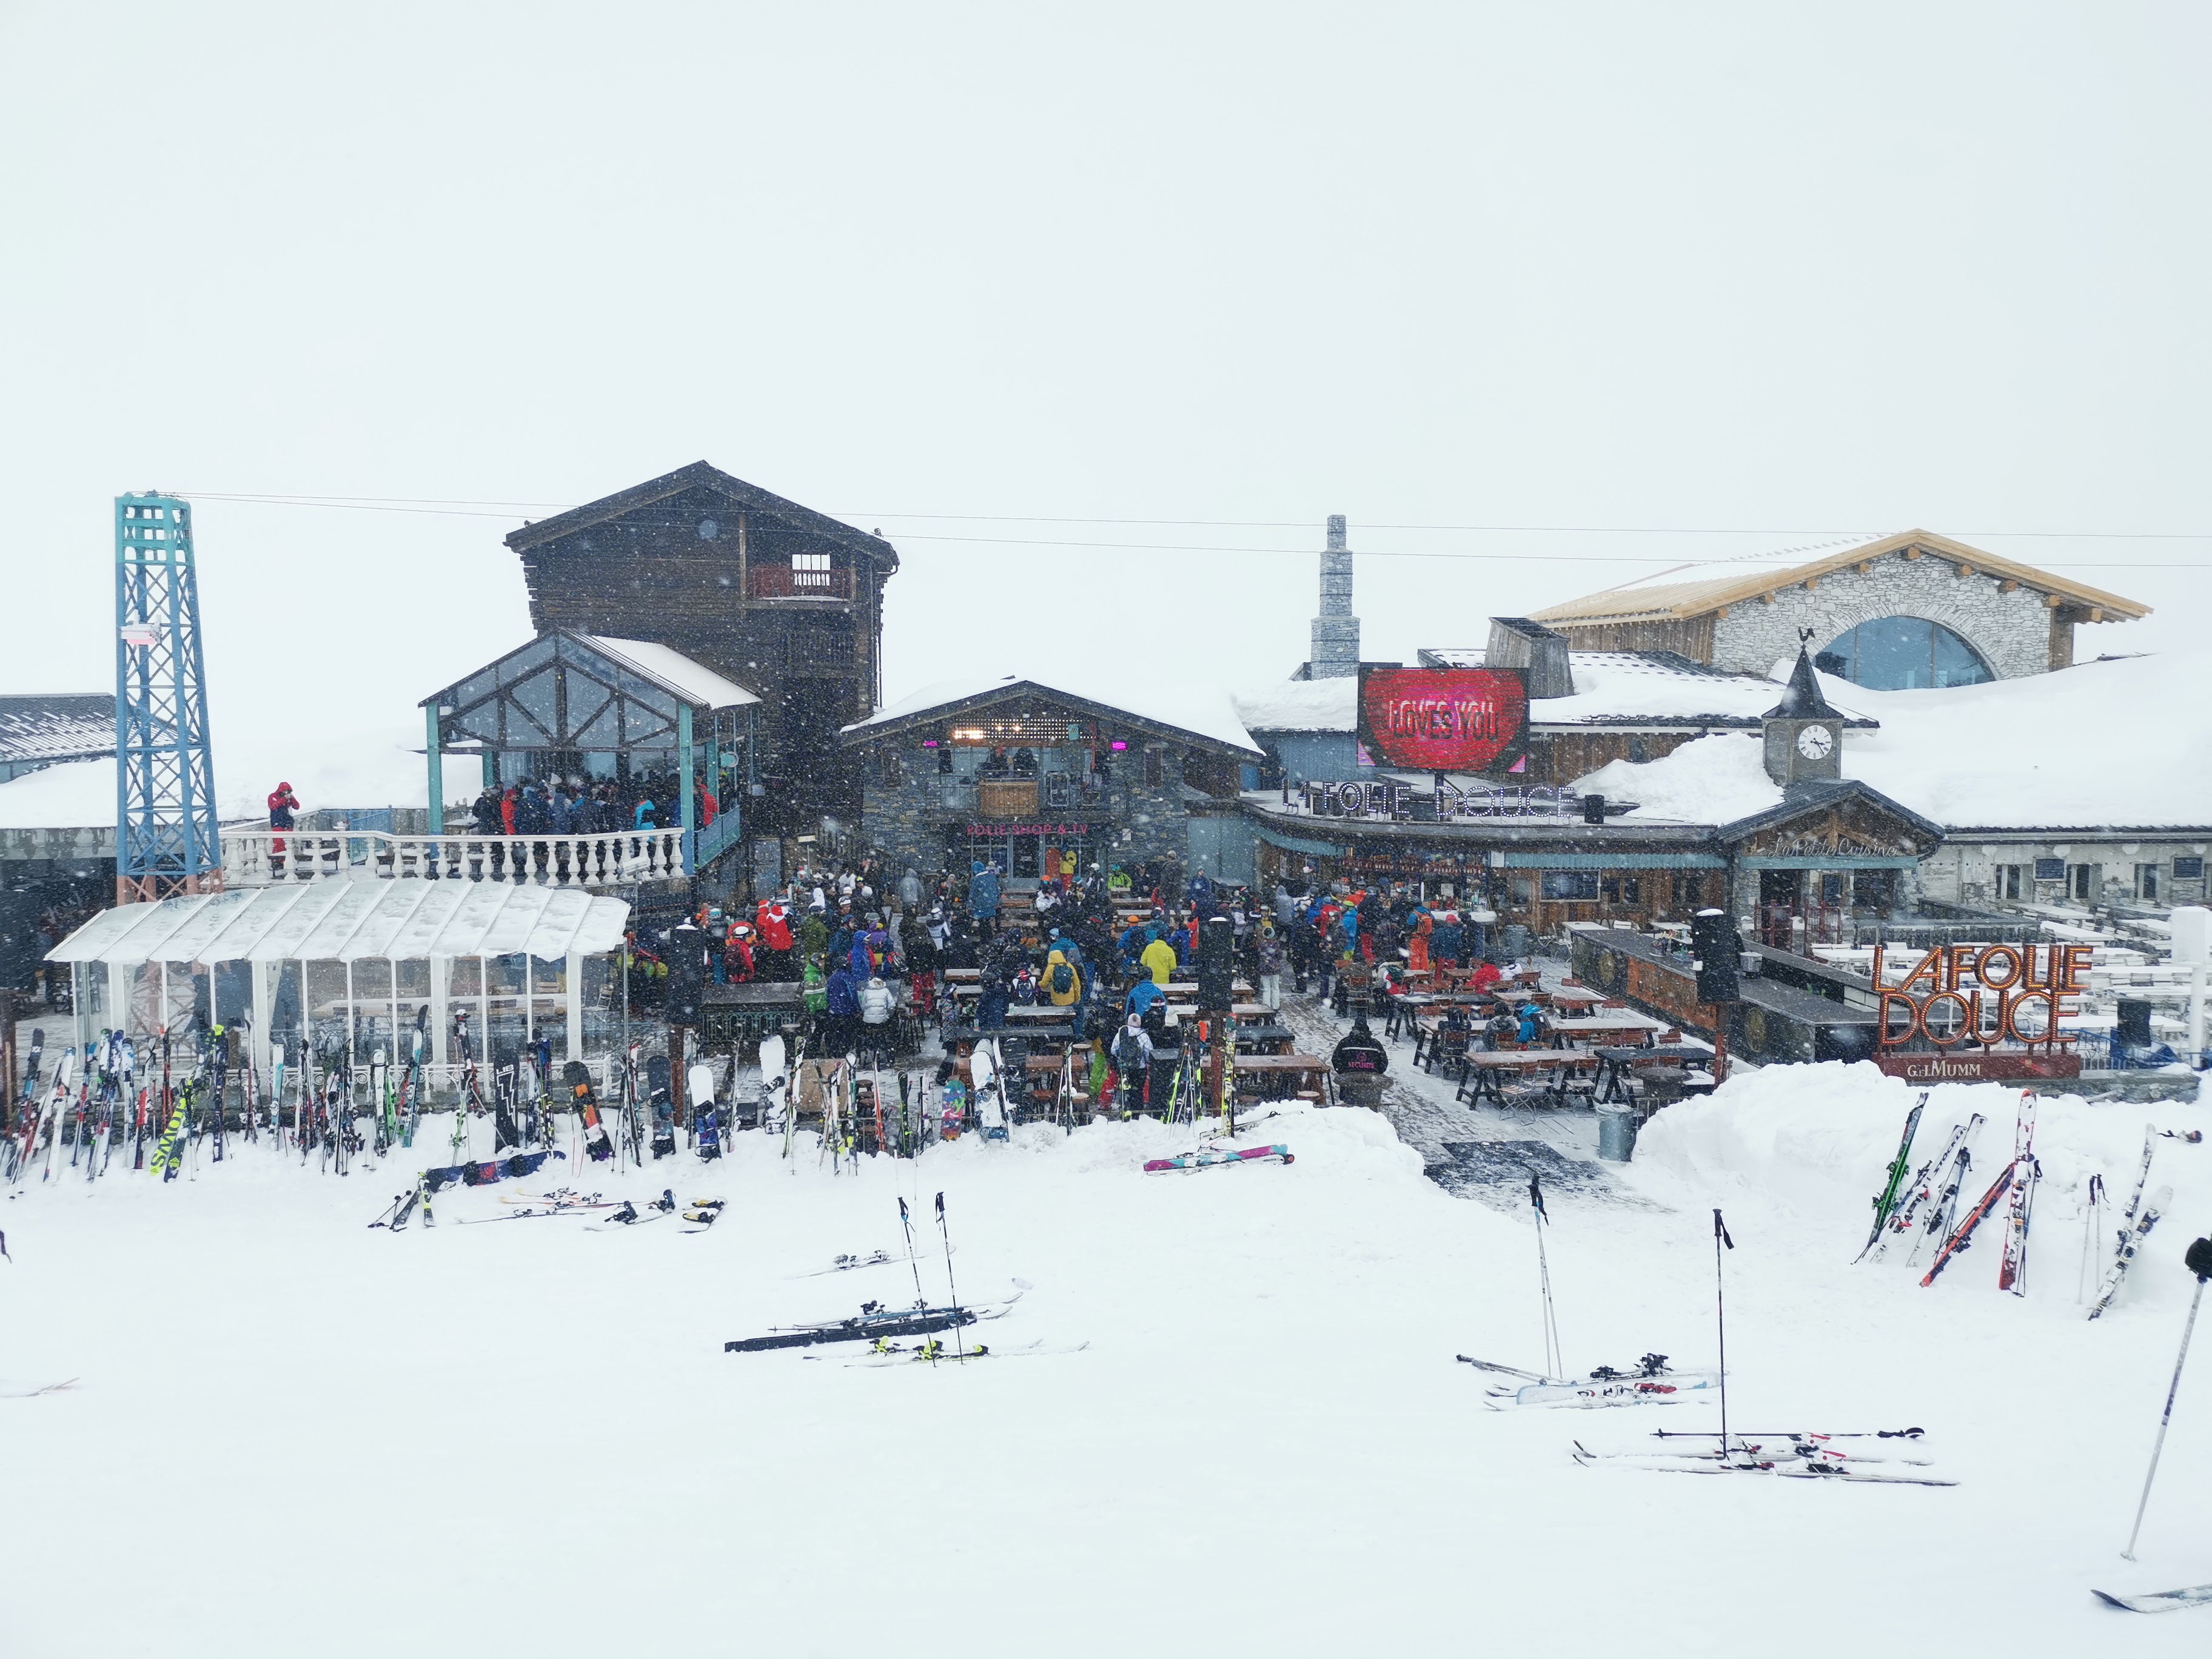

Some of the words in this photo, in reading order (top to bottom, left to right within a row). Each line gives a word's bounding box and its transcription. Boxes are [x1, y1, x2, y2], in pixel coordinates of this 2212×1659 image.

[1455, 701, 1498, 740] YOU
[1282, 779, 1310, 807] LA
[1322, 782, 1410, 814] FOLIE
[1436, 786, 1574, 817] DOUCE
[967, 825, 1006, 836] FOLIE
[1011, 825, 1052, 836] SHOP
[1057, 825, 1066, 834] &
[1791, 838, 1836, 857] Petite
[1838, 837, 1898, 857] Cuisine
[1871, 945, 1943, 993] LA
[1947, 944, 2093, 991] FOLIE
[1880, 990, 2081, 1044] DOUCE
